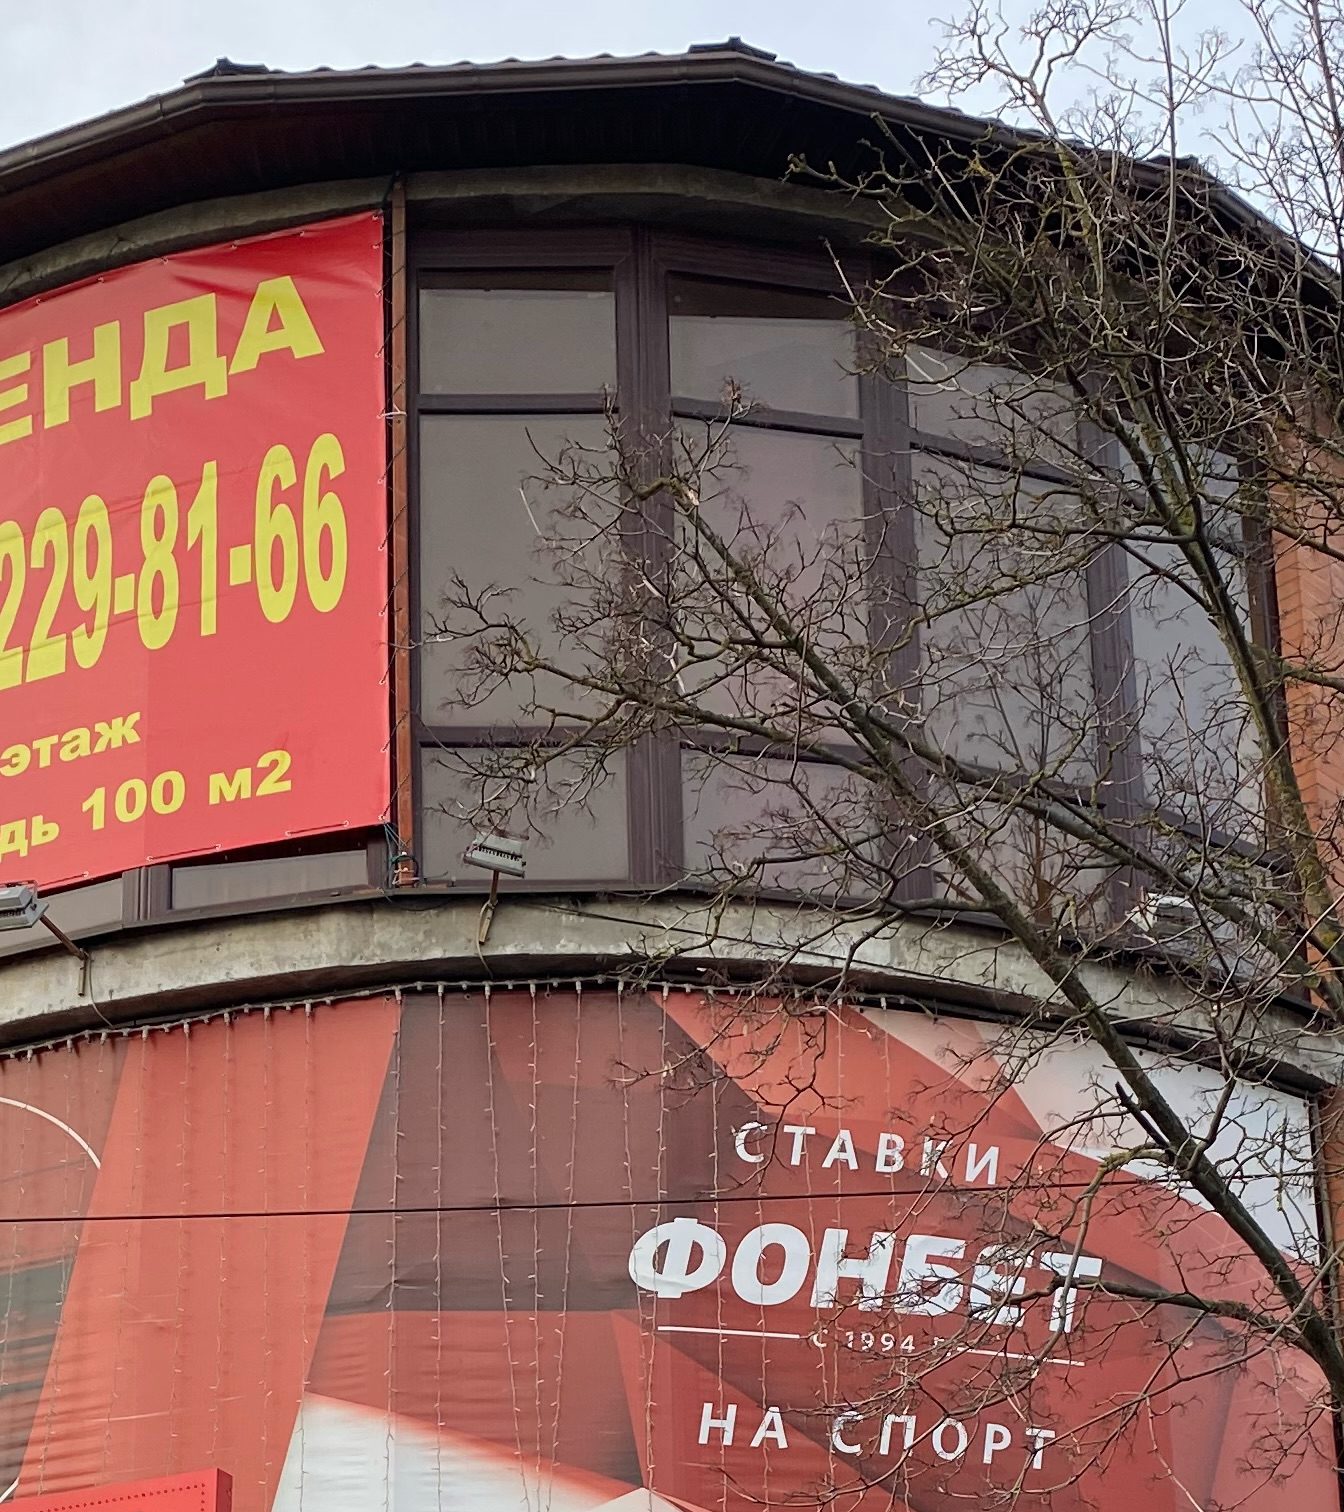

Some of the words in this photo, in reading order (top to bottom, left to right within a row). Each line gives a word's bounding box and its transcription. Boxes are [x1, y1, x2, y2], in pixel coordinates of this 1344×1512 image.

[0, 708, 142, 777] этаж
[81, 769, 186, 830] 100
[209, 750, 292, 805] м2
[735, 1121, 999, 1185] СТАВКИ
[627, 1216, 1103, 1335] ФОНБЕТ
[698, 1402, 788, 1449] НА
[831, 1410, 1056, 1470] СПОРТ
